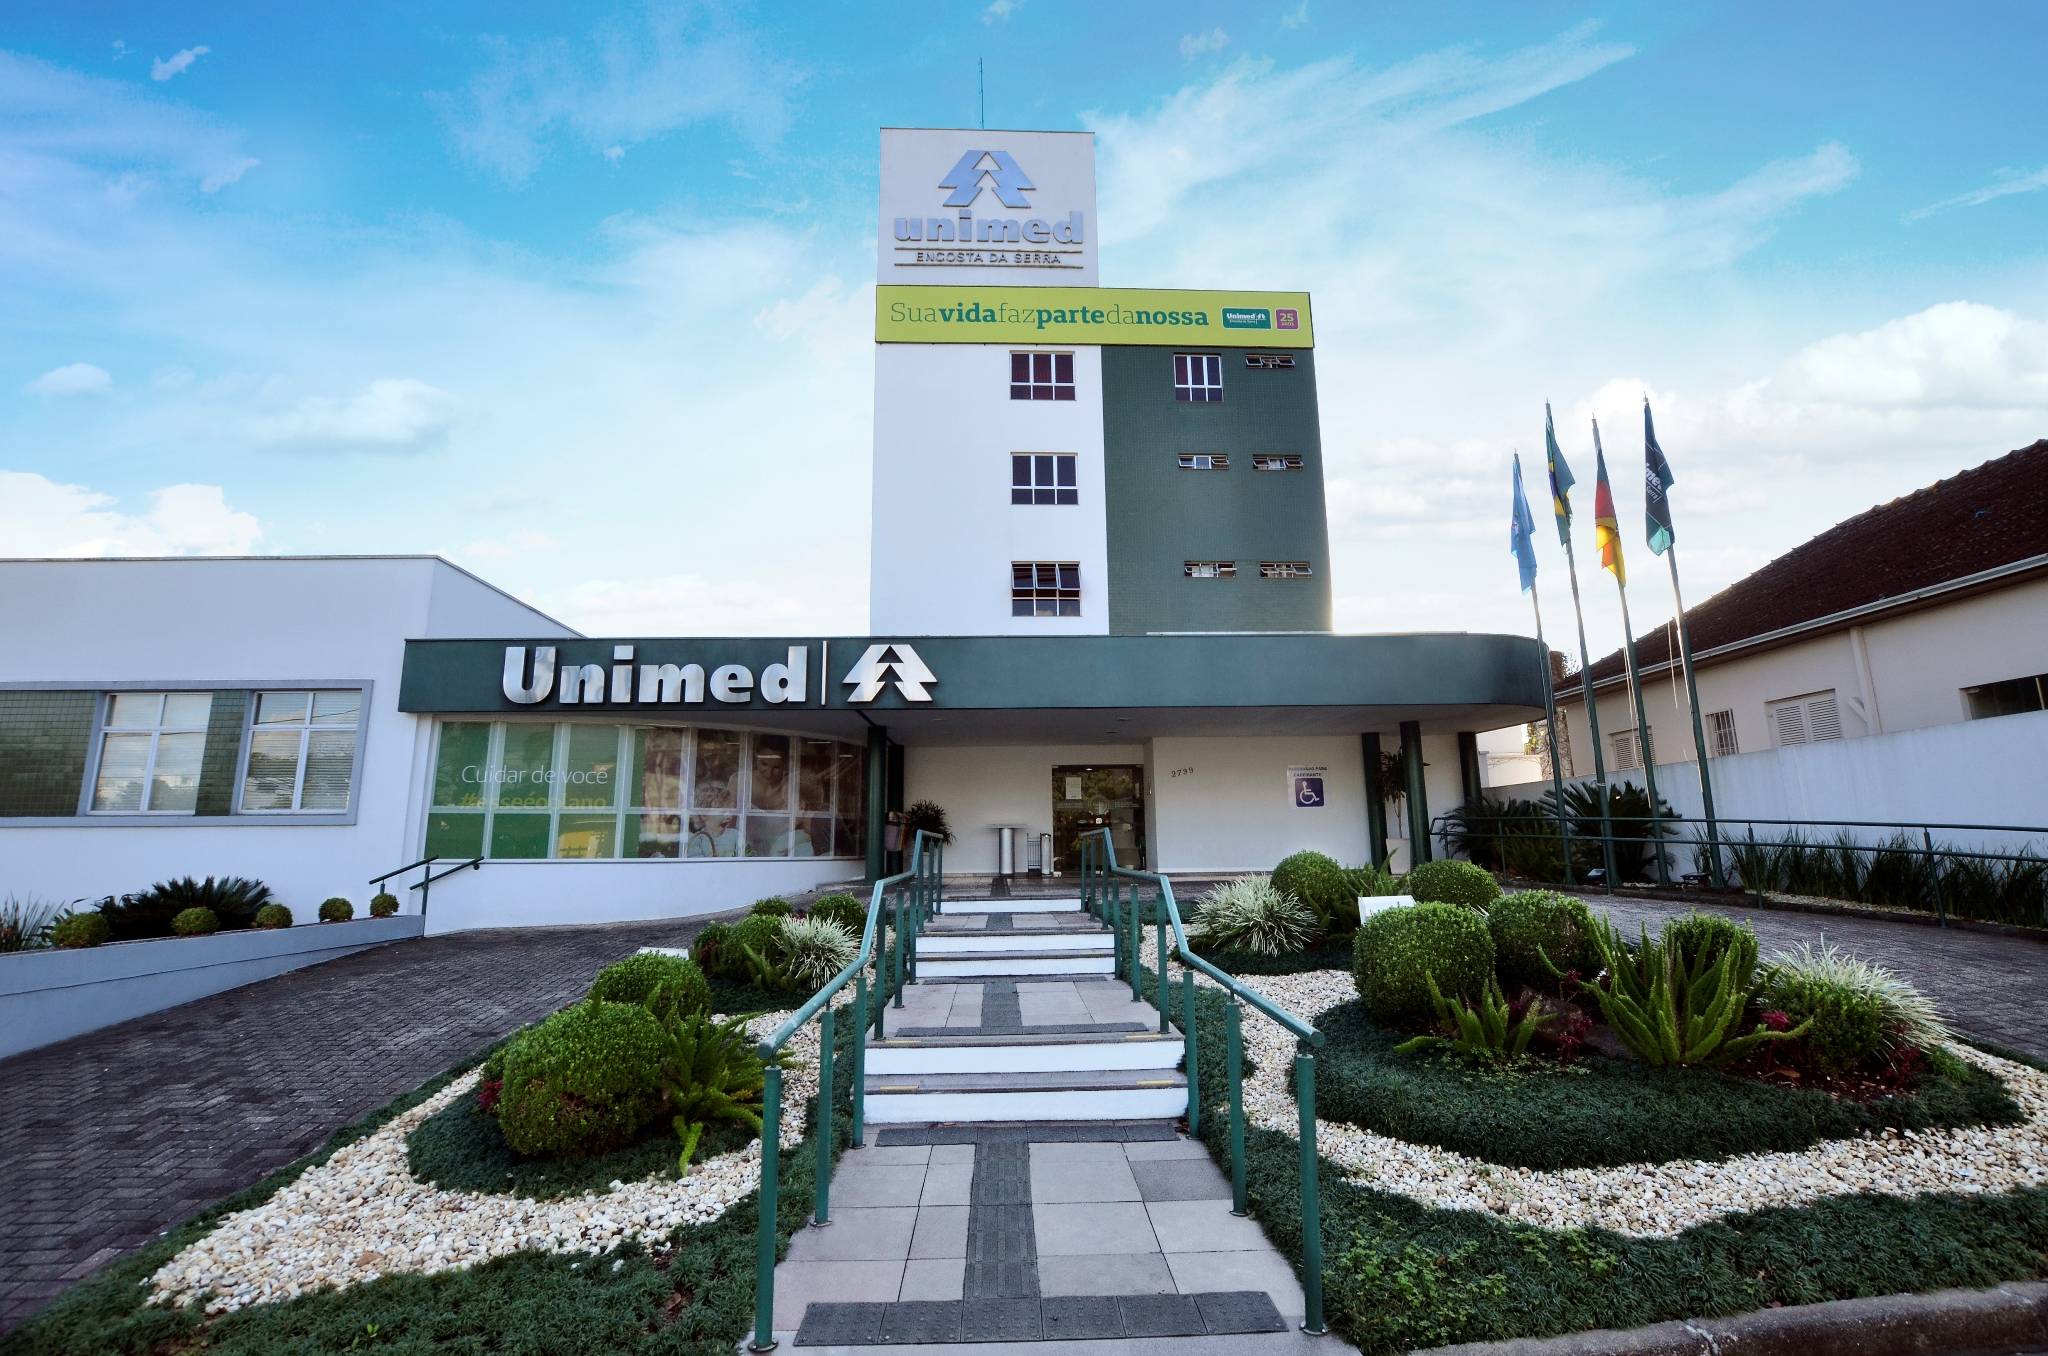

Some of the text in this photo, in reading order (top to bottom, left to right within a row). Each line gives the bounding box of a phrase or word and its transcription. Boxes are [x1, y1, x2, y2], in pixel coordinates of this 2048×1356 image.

[894, 208, 1084, 244] unimed
[916, 252, 1061, 264] ENCOSTA DA SERRA
[1226, 312, 1256, 320] Unimed
[1279, 313, 1294, 322] 25
[502, 645, 808, 704] Unimed
[461, 764, 526, 783] Cuidar
[531, 764, 556, 784] de
